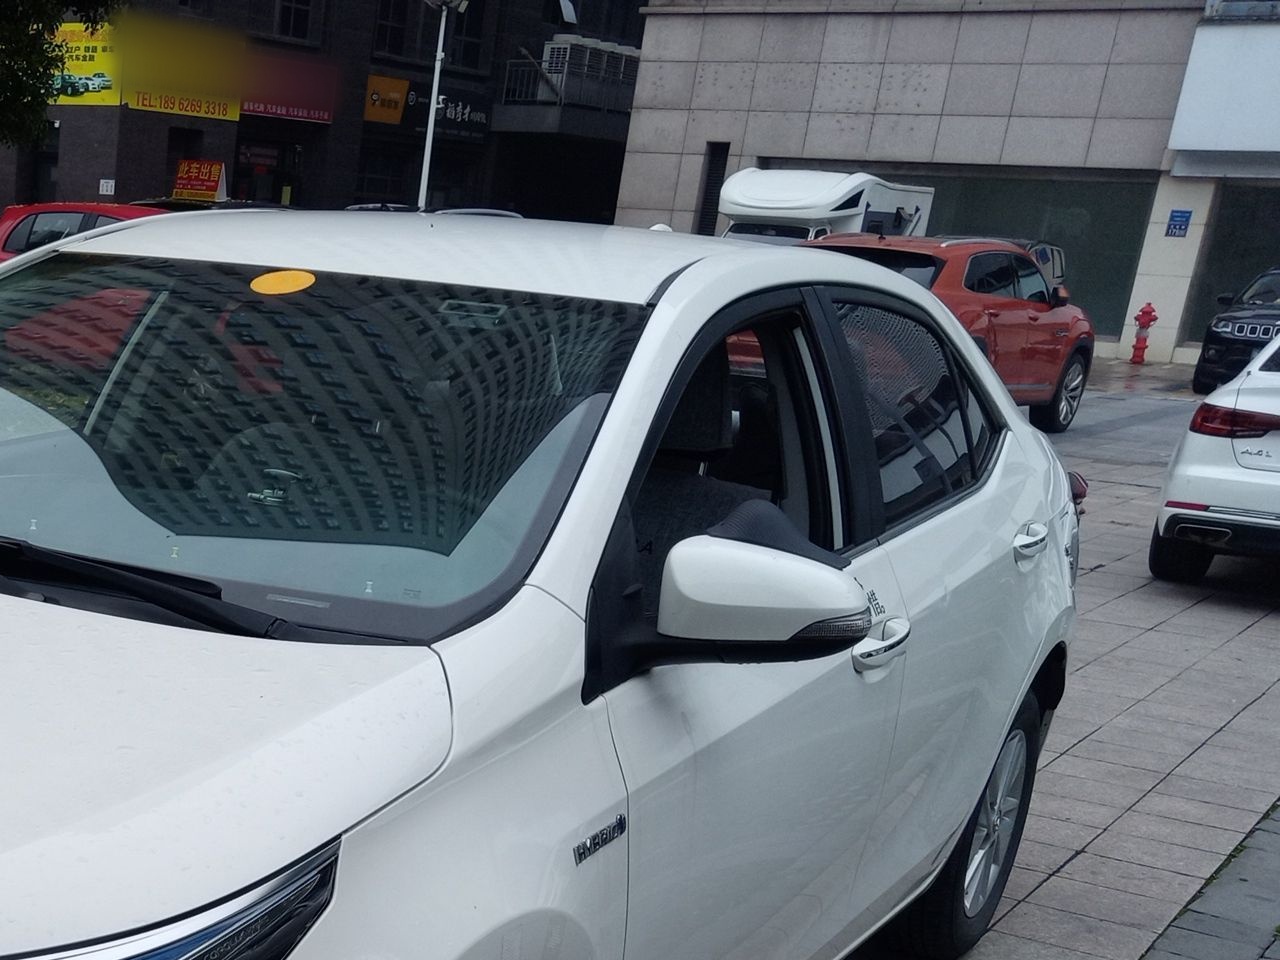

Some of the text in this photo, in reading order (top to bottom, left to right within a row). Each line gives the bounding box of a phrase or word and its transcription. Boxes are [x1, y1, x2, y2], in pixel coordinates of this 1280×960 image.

[135, 91, 229, 117] TEL:189 6269 3318
[177, 160, 221, 181] 此车出售
